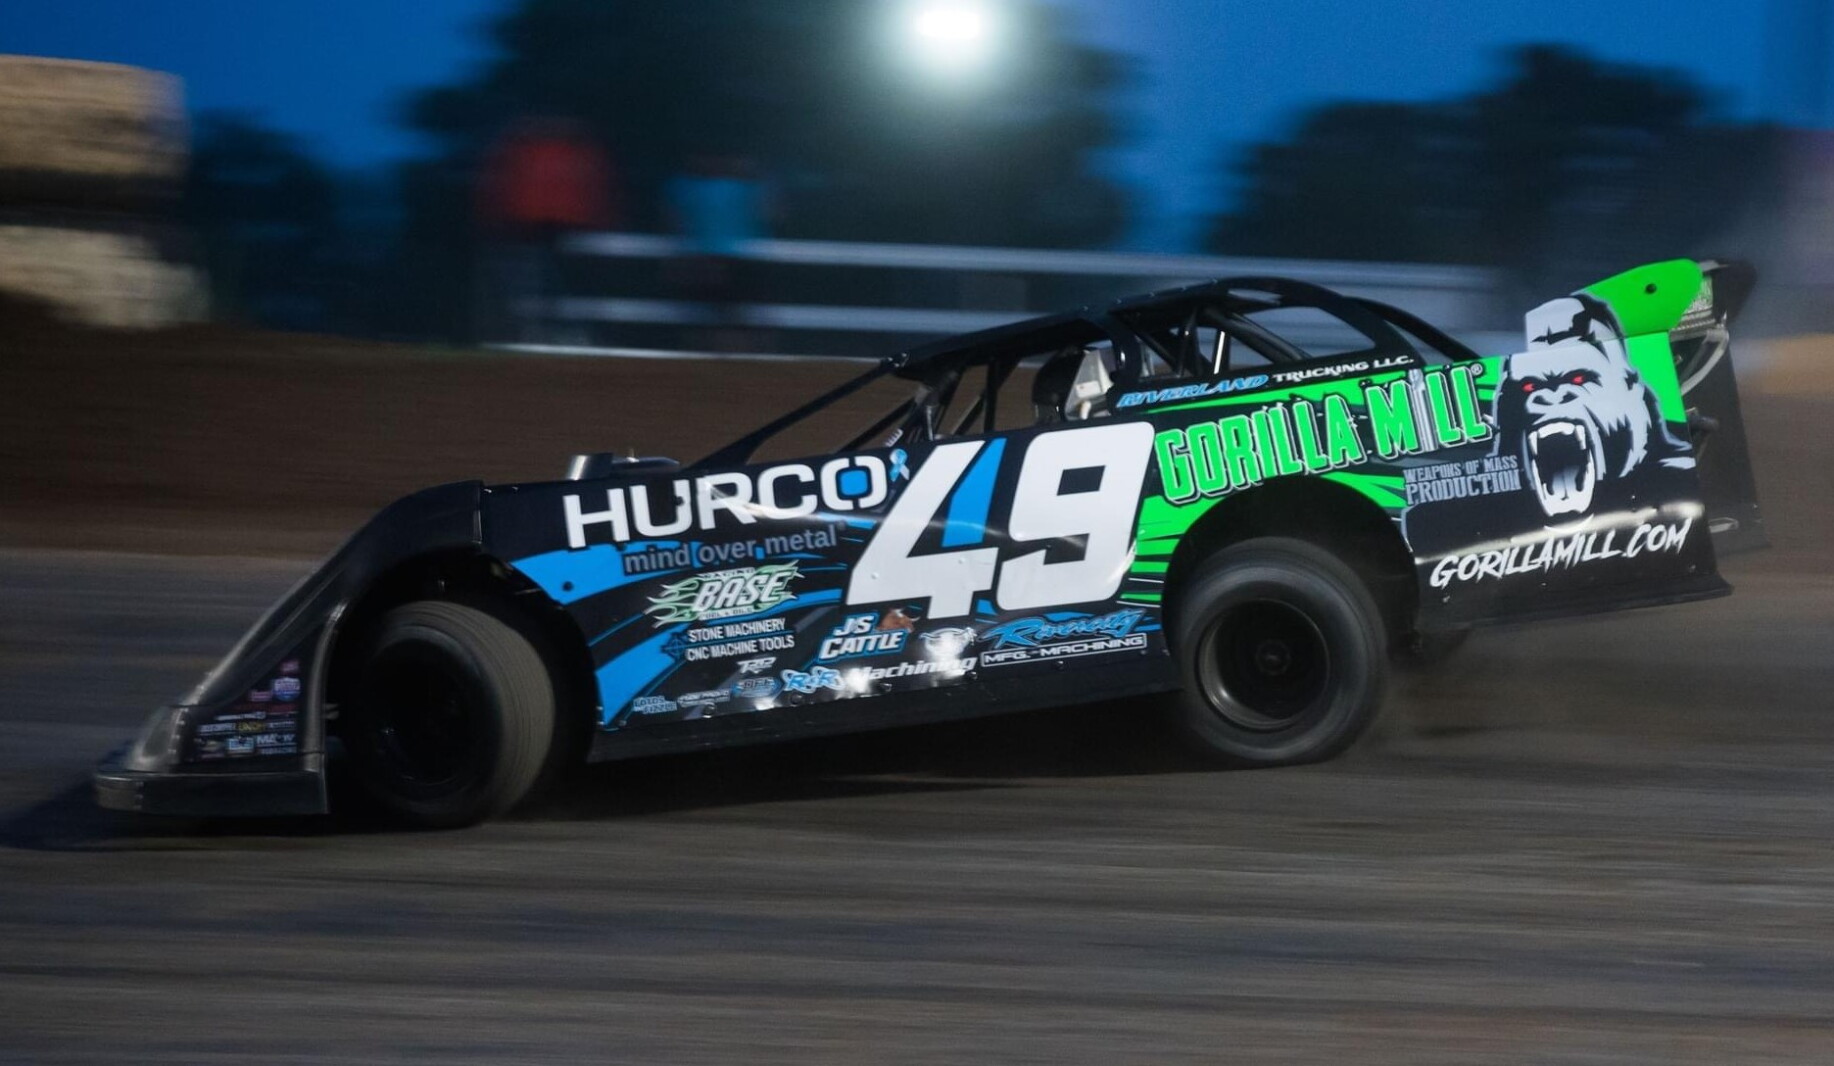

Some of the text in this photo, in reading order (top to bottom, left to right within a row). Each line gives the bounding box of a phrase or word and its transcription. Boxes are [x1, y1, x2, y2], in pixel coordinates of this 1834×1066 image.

[1116, 374, 1270, 408] RIVERLAND
[1273, 362, 1369, 384] TRUCKING
[1155, 394, 1368, 504] GORILLA
[1402, 455, 1518, 483] WEAPONS OF MASS
[563, 455, 888, 549] HURCO
[1404, 468, 1522, 506] PRODUCTION
[846, 421, 1155, 620] 49
[625, 525, 837, 573] mind over metal
[1429, 518, 1694, 589] GORILLAMILL.COM
[692, 570, 790, 611] BASE
[686, 634, 795, 662] CNC MACHINE TOOLS
[687, 617, 787, 643] STONE MACHINERY
[820, 631, 903, 660] CATTLE
[1040, 636, 1144, 657] MACHINING
